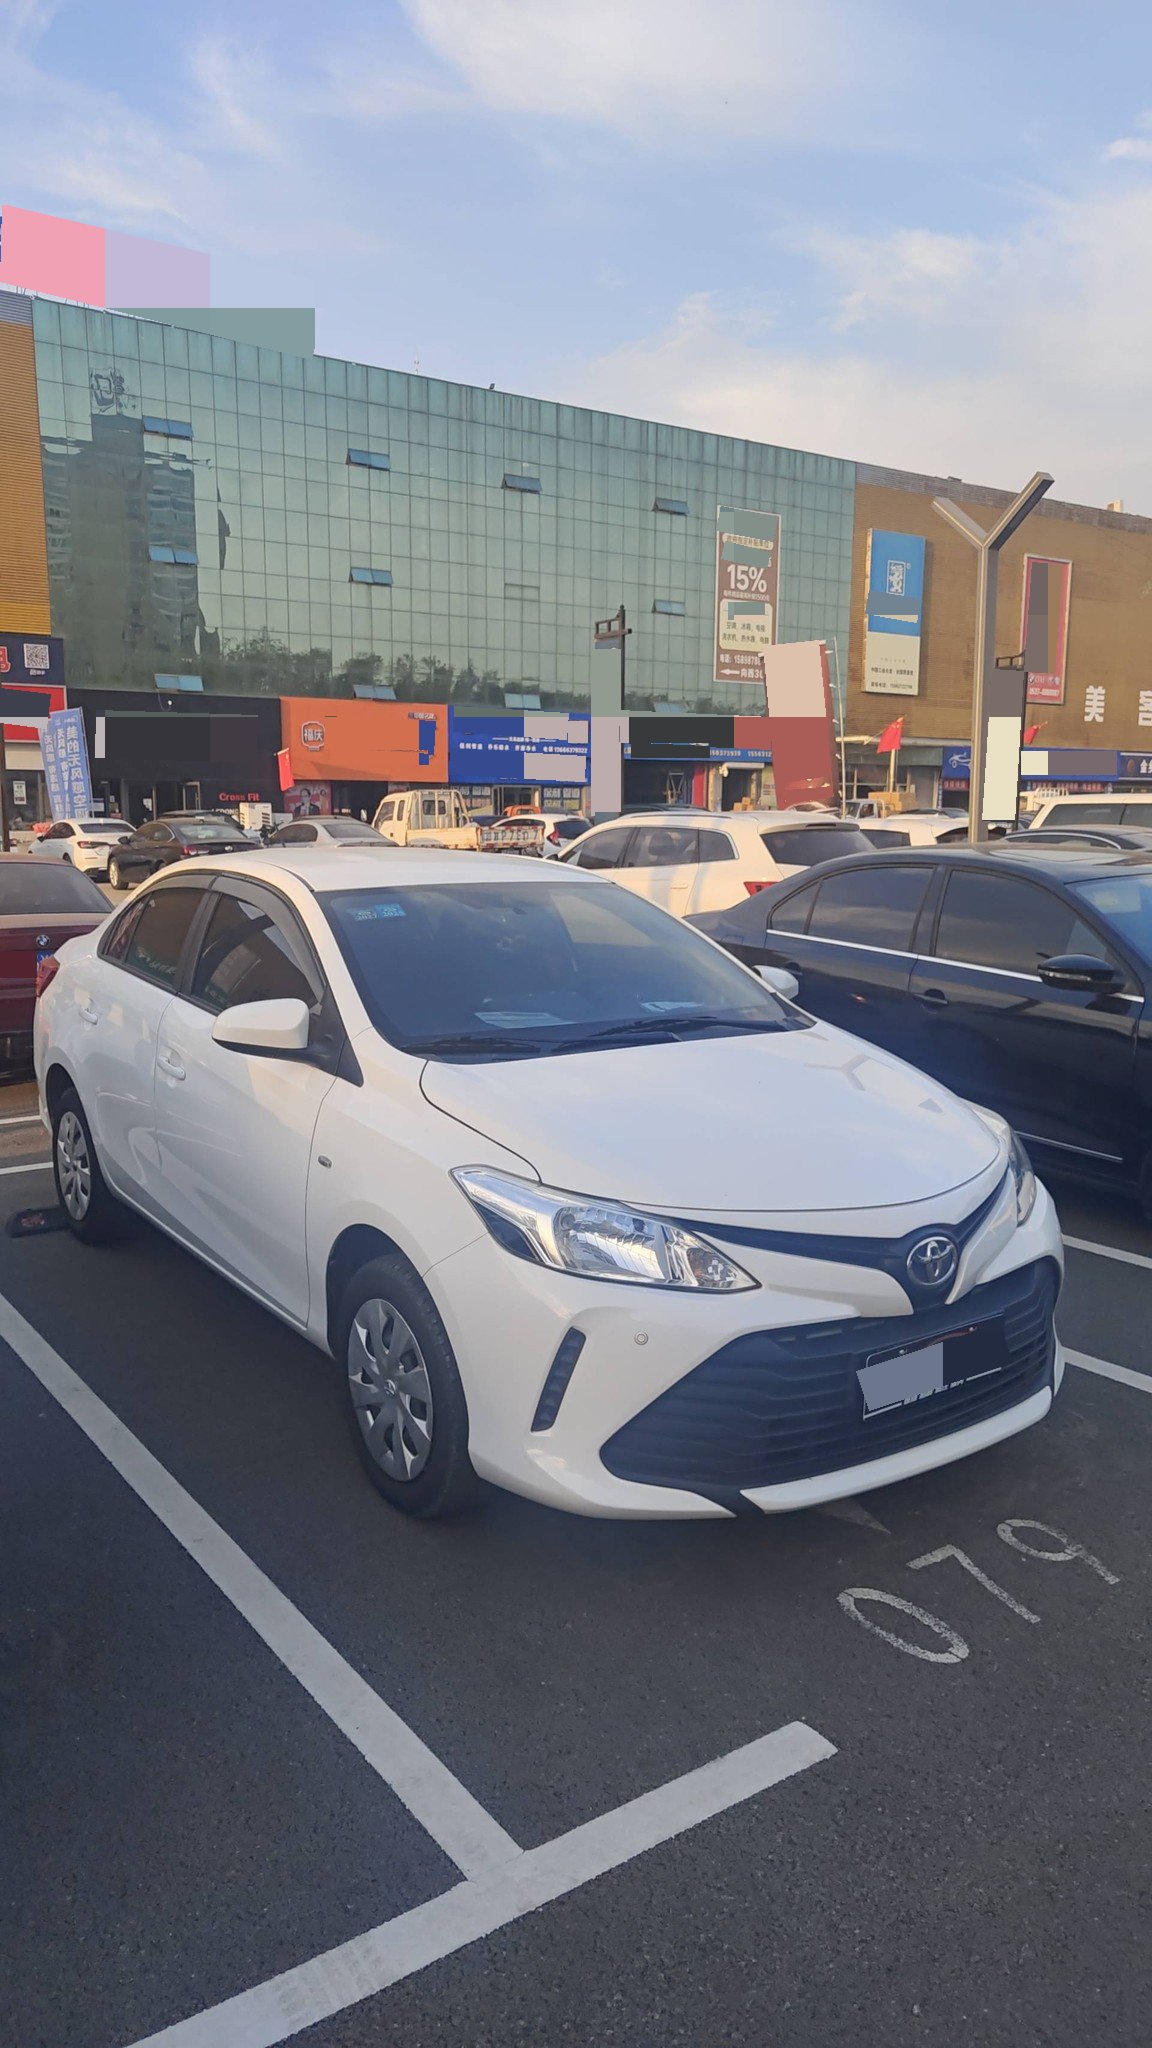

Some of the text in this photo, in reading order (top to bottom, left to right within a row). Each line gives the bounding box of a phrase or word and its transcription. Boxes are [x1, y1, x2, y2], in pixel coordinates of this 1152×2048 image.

[727, 564, 767, 593] 15%
[303, 728, 324, 742] 福庆
[219, 793, 260, 801] Cross Fit
[837, 1519, 1120, 1664] 079
